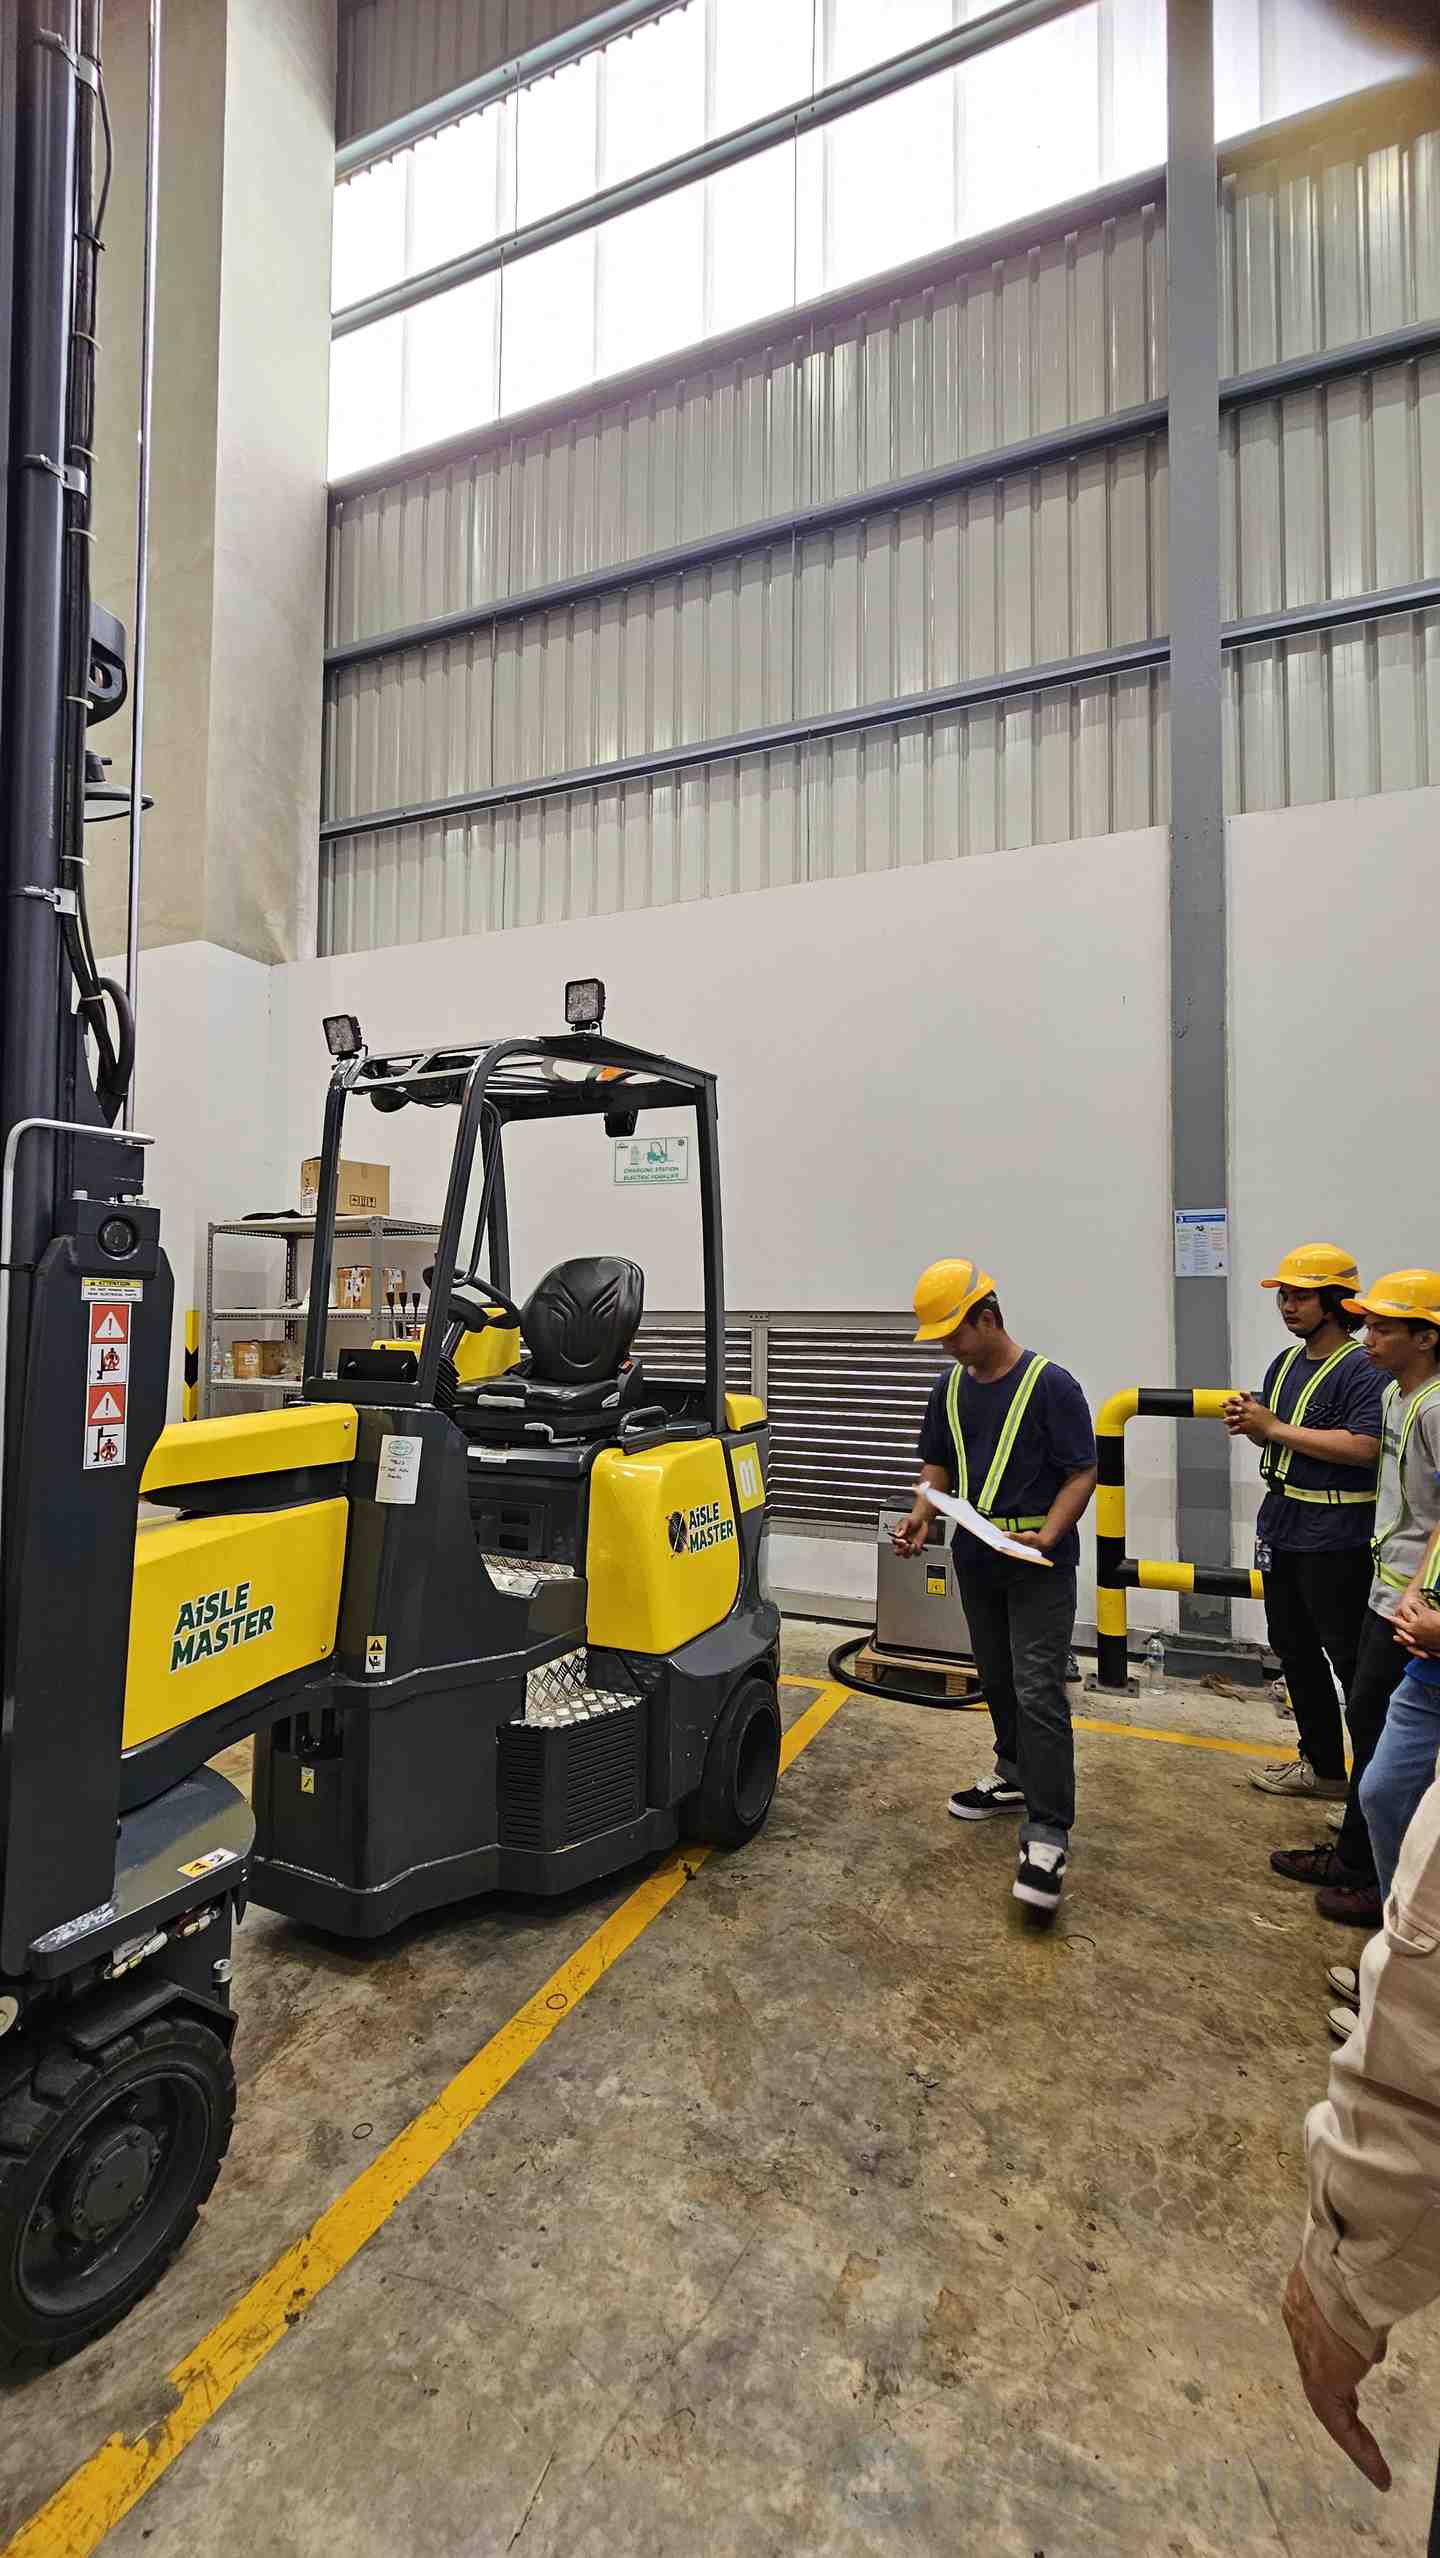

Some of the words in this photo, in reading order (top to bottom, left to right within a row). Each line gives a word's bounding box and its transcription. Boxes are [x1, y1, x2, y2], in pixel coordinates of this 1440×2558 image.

[738, 1458, 758, 1498] 01
[688, 1519, 734, 1554] MASTER
[169, 1603, 275, 1673] MASTER
